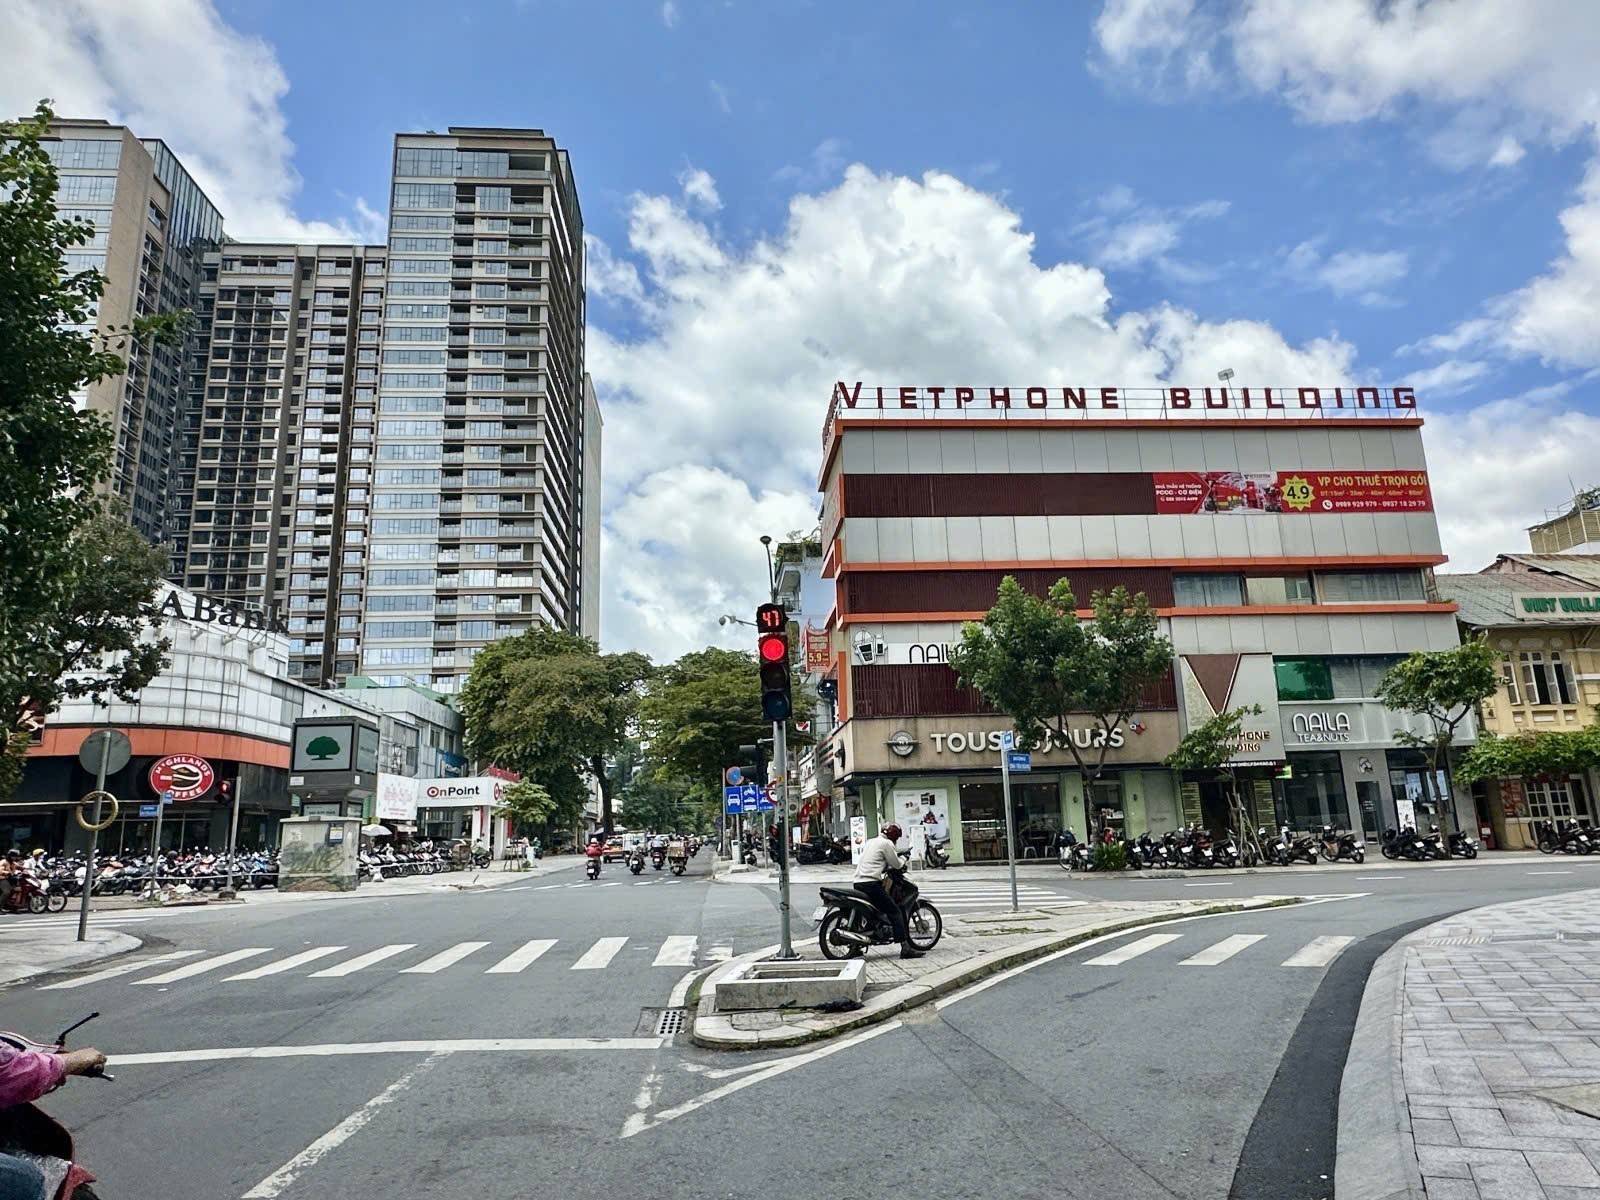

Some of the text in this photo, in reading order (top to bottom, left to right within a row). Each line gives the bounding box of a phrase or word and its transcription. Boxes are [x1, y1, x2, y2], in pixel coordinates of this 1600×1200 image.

[838, 382, 1416, 409] VIETPHONE BUILDING
[1317, 473, 1427, 489] VP CHO THUÊ TRỌN GÓI
[1286, 485, 1310, 500] 4.9
[762, 610, 780, 626] 47
[909, 643, 962, 664] NAIL
[1292, 712, 1351, 732] NAILA
[930, 731, 1002, 753] TOUS
[1297, 732, 1350, 743] TEA&NUTS
[427, 785, 480, 798] OnPoint
